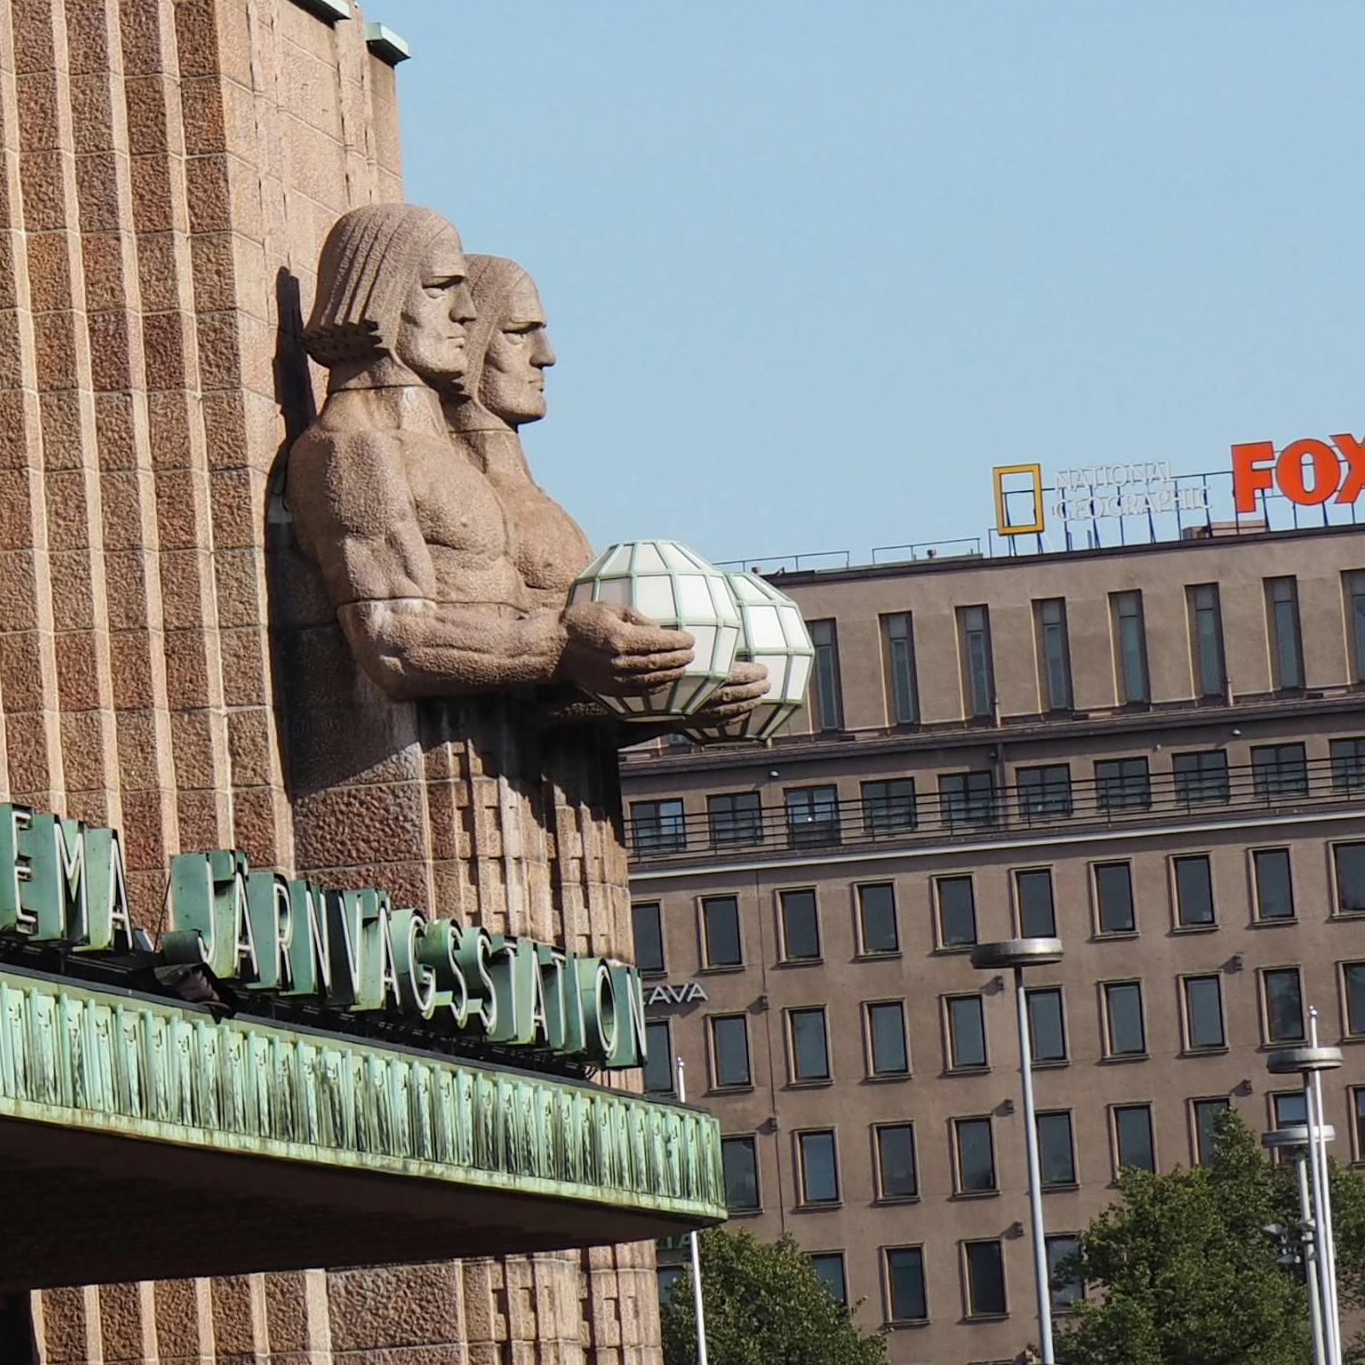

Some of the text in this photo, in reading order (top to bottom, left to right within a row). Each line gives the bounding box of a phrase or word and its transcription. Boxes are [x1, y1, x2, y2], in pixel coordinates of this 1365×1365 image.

[1055, 460, 1176, 492] NATIONAL
[1231, 433, 1365, 514] FOX
[1053, 486, 1213, 522] GEOGRAPHIC
[161, 849, 646, 1068] JÄRNVÄGSSTATION
[643, 982, 709, 1005] AVA
